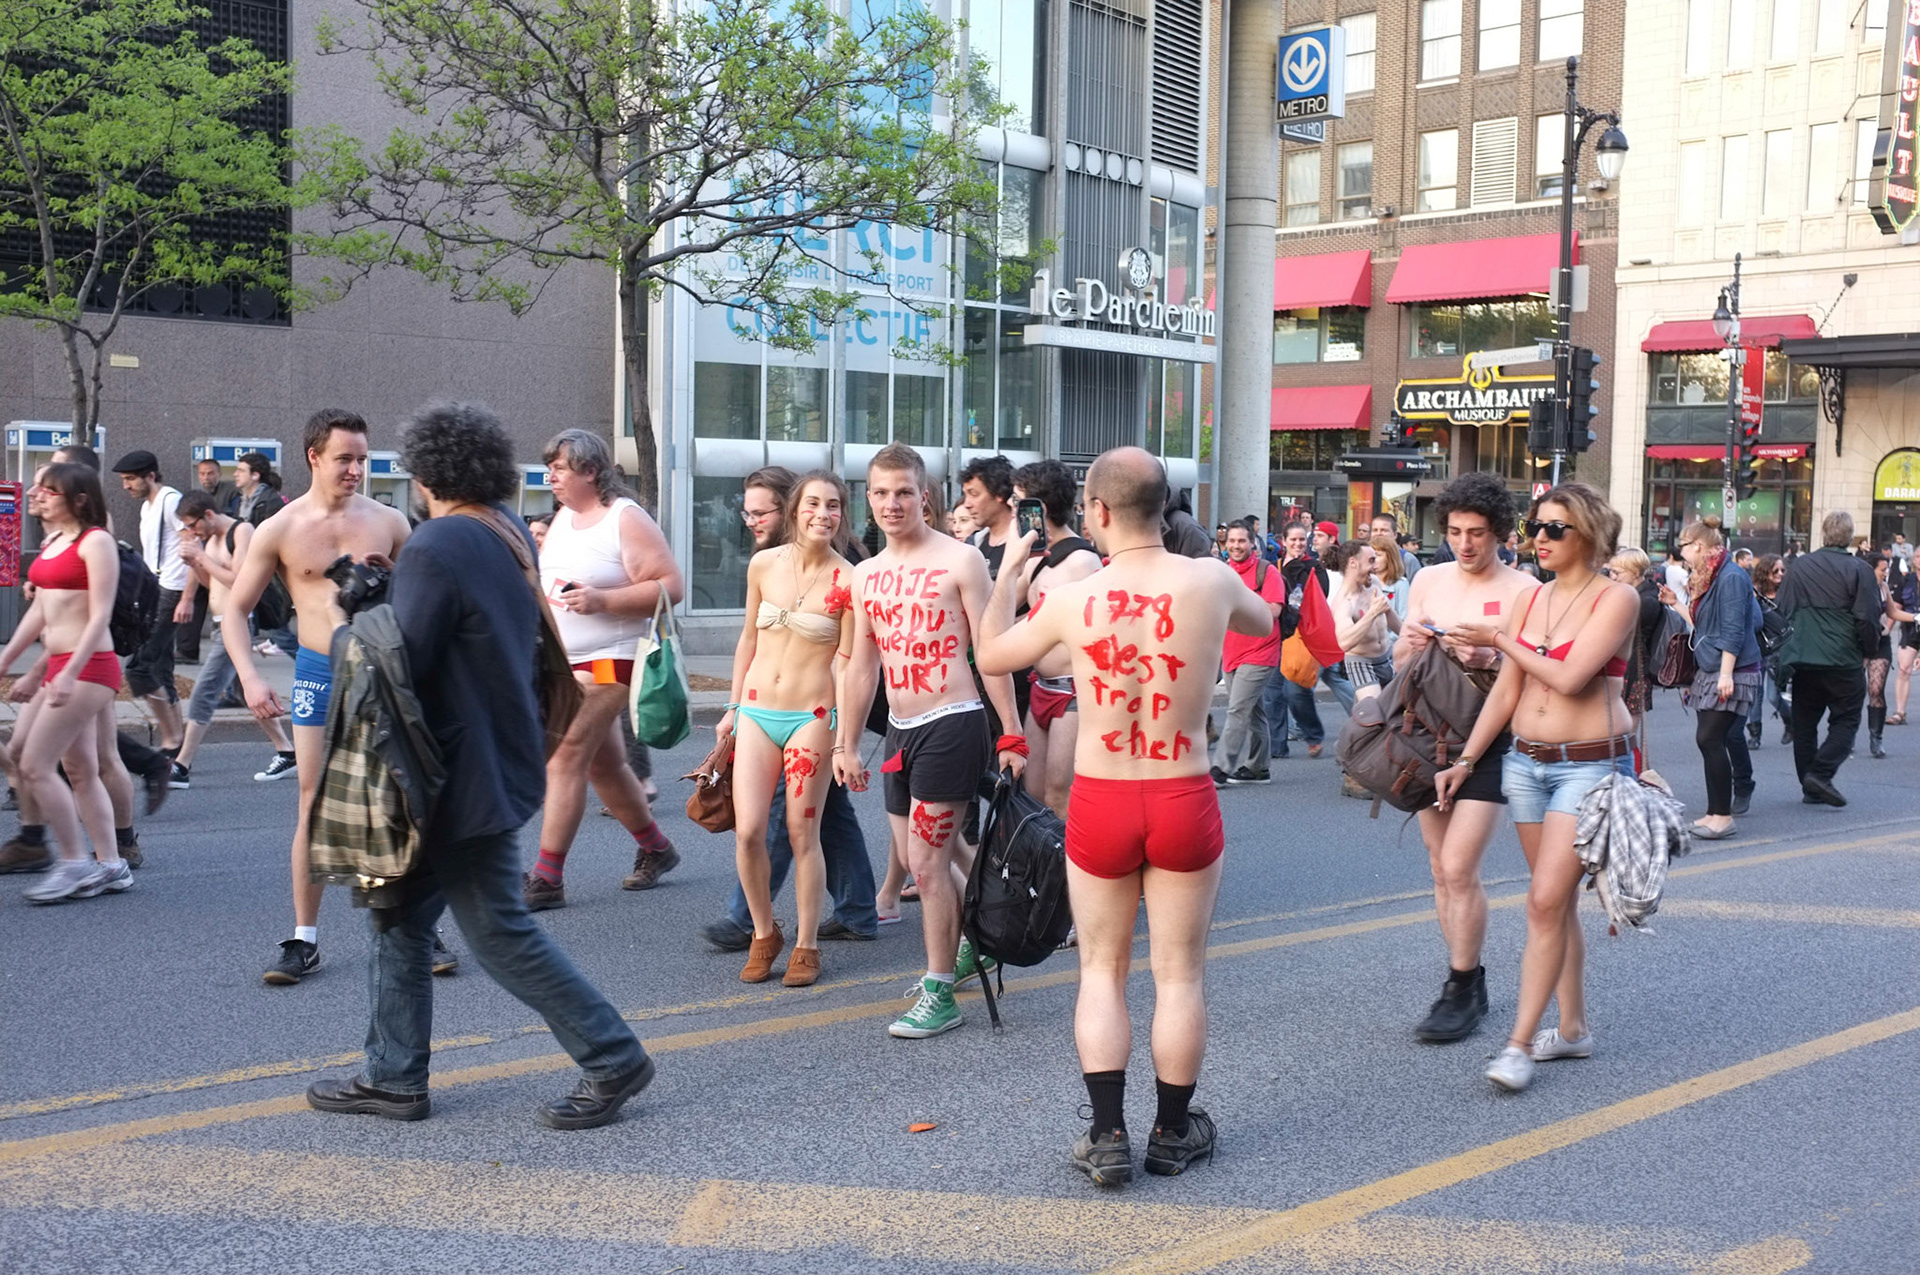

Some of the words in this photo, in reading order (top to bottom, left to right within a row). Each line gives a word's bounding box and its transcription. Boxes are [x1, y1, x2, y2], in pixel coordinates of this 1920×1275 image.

[1280, 96, 1327, 118] METRO
[847, 269, 934, 291] TRANSPORT
[1033, 268, 1073, 317] le
[1076, 278, 1216, 336] Parchemin
[726, 296, 933, 349] COLECTIF
[51, 432, 72, 446] Bel
[905, 567, 949, 599] JE
[910, 604, 945, 633] DU
[1089, 676, 1172, 721] trop
[1101, 720, 1192, 762] cher
